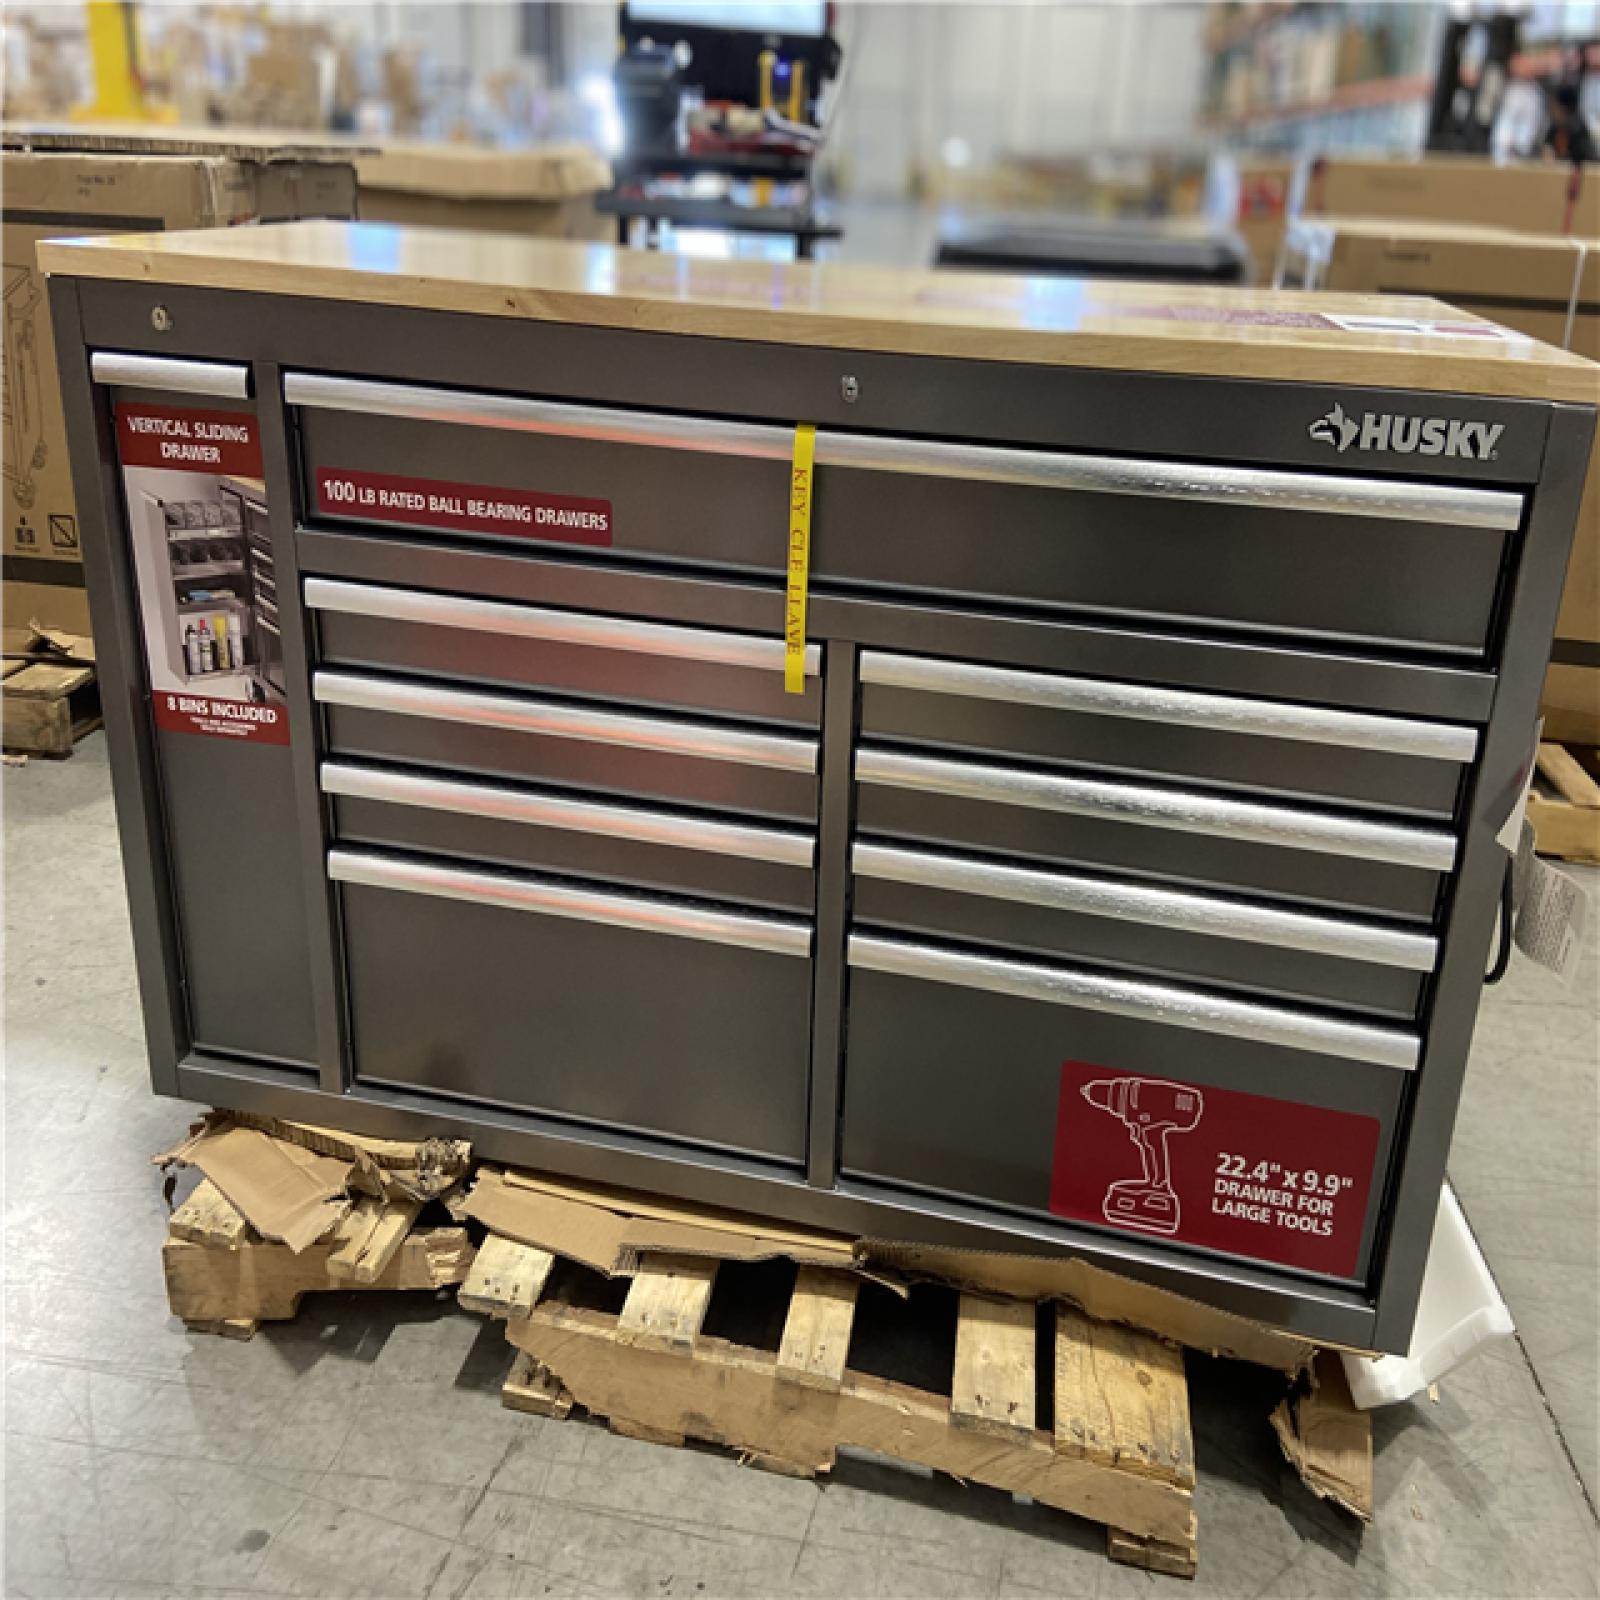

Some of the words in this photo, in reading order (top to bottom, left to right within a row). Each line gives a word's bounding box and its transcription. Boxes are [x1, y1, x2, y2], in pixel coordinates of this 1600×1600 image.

[127, 415, 191, 439] VERTICAL
[194, 421, 249, 443] SLIDING
[1360, 412, 1505, 460] HUSKY
[160, 441, 221, 463] DRAWER
[323, 479, 356, 503] 100
[359, 487, 376, 505] LB
[379, 489, 426, 511] RATED
[428, 494, 465, 516] BALL
[467, 499, 531, 523] BEARING
[534, 506, 608, 531] DRAWERS
[211, 702, 277, 724] INCLUDED
[1215, 1152, 1281, 1183] 22.4"
[1302, 1169, 1354, 1196] 9.9"
[1214, 1177, 1293, 1208] DRAWER
[1297, 1194, 1334, 1216] FOR
[1211, 1198, 1271, 1224] LARGE
[1275, 1209, 1334, 1236] TOOLS
